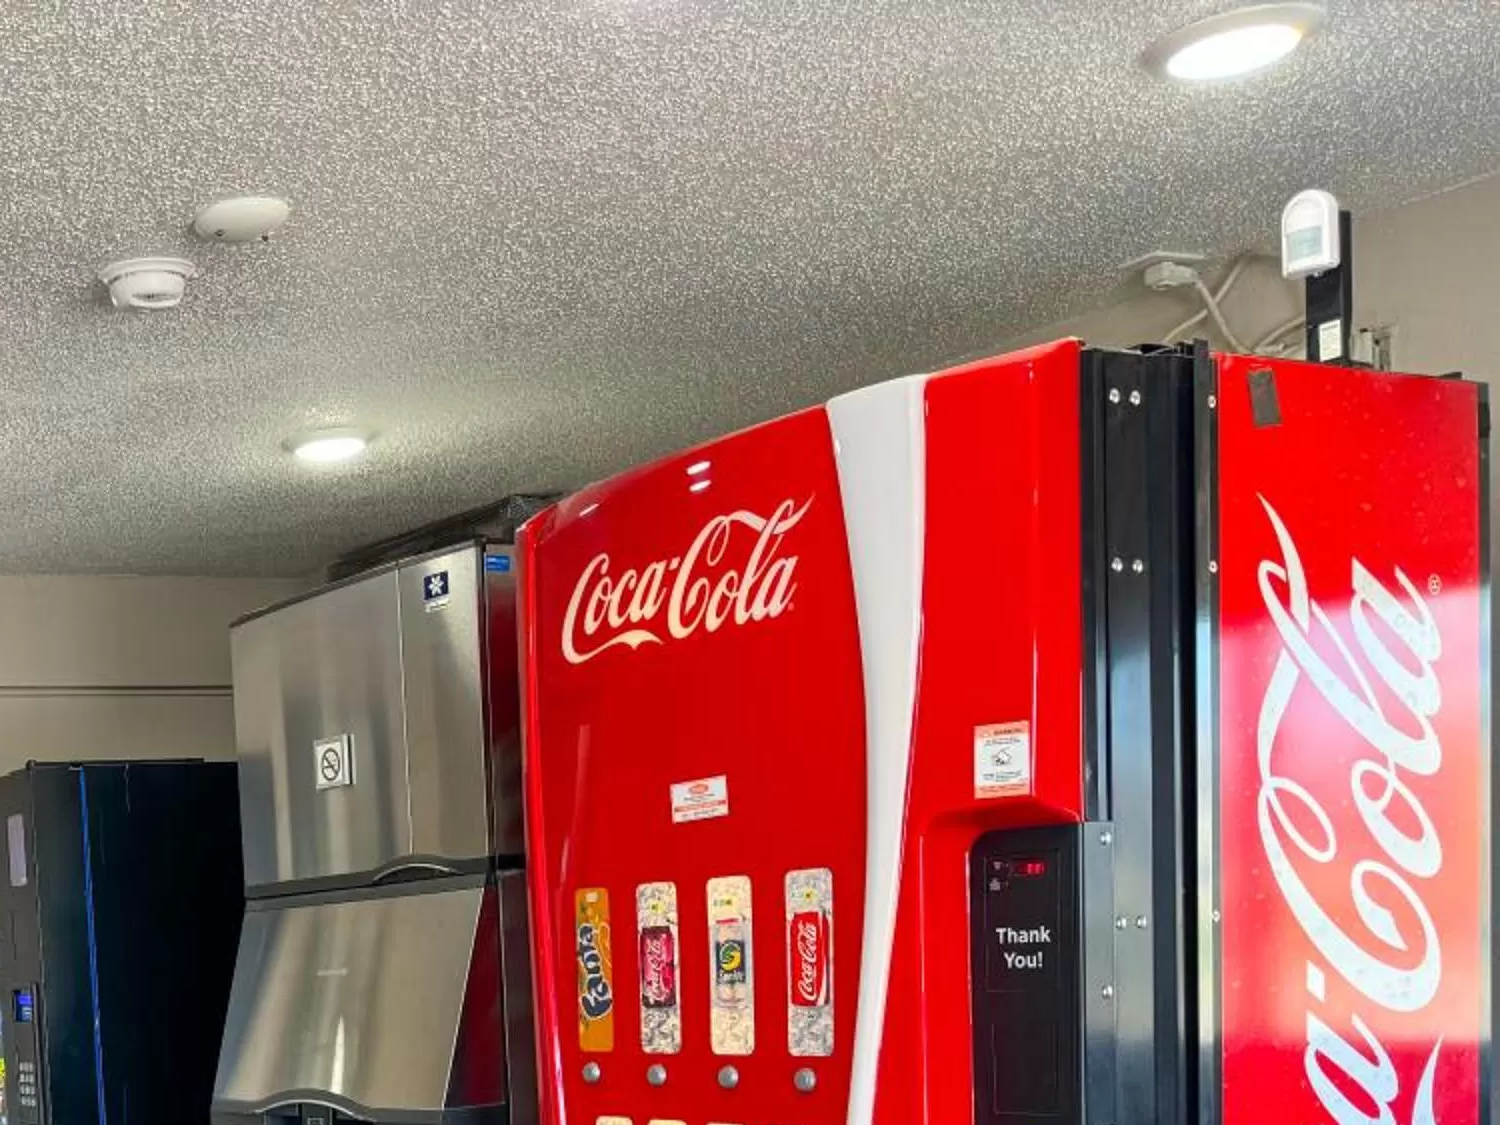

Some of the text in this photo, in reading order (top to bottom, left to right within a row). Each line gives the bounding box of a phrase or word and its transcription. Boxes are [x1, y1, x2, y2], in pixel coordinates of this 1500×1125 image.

[562, 494, 814, 664] Coca-Cola
[578, 923, 612, 1019] Fanta
[797, 921, 818, 1001] Coca-Cola
[995, 925, 1051, 944] Thank
[1003, 952, 1044, 969] You!
